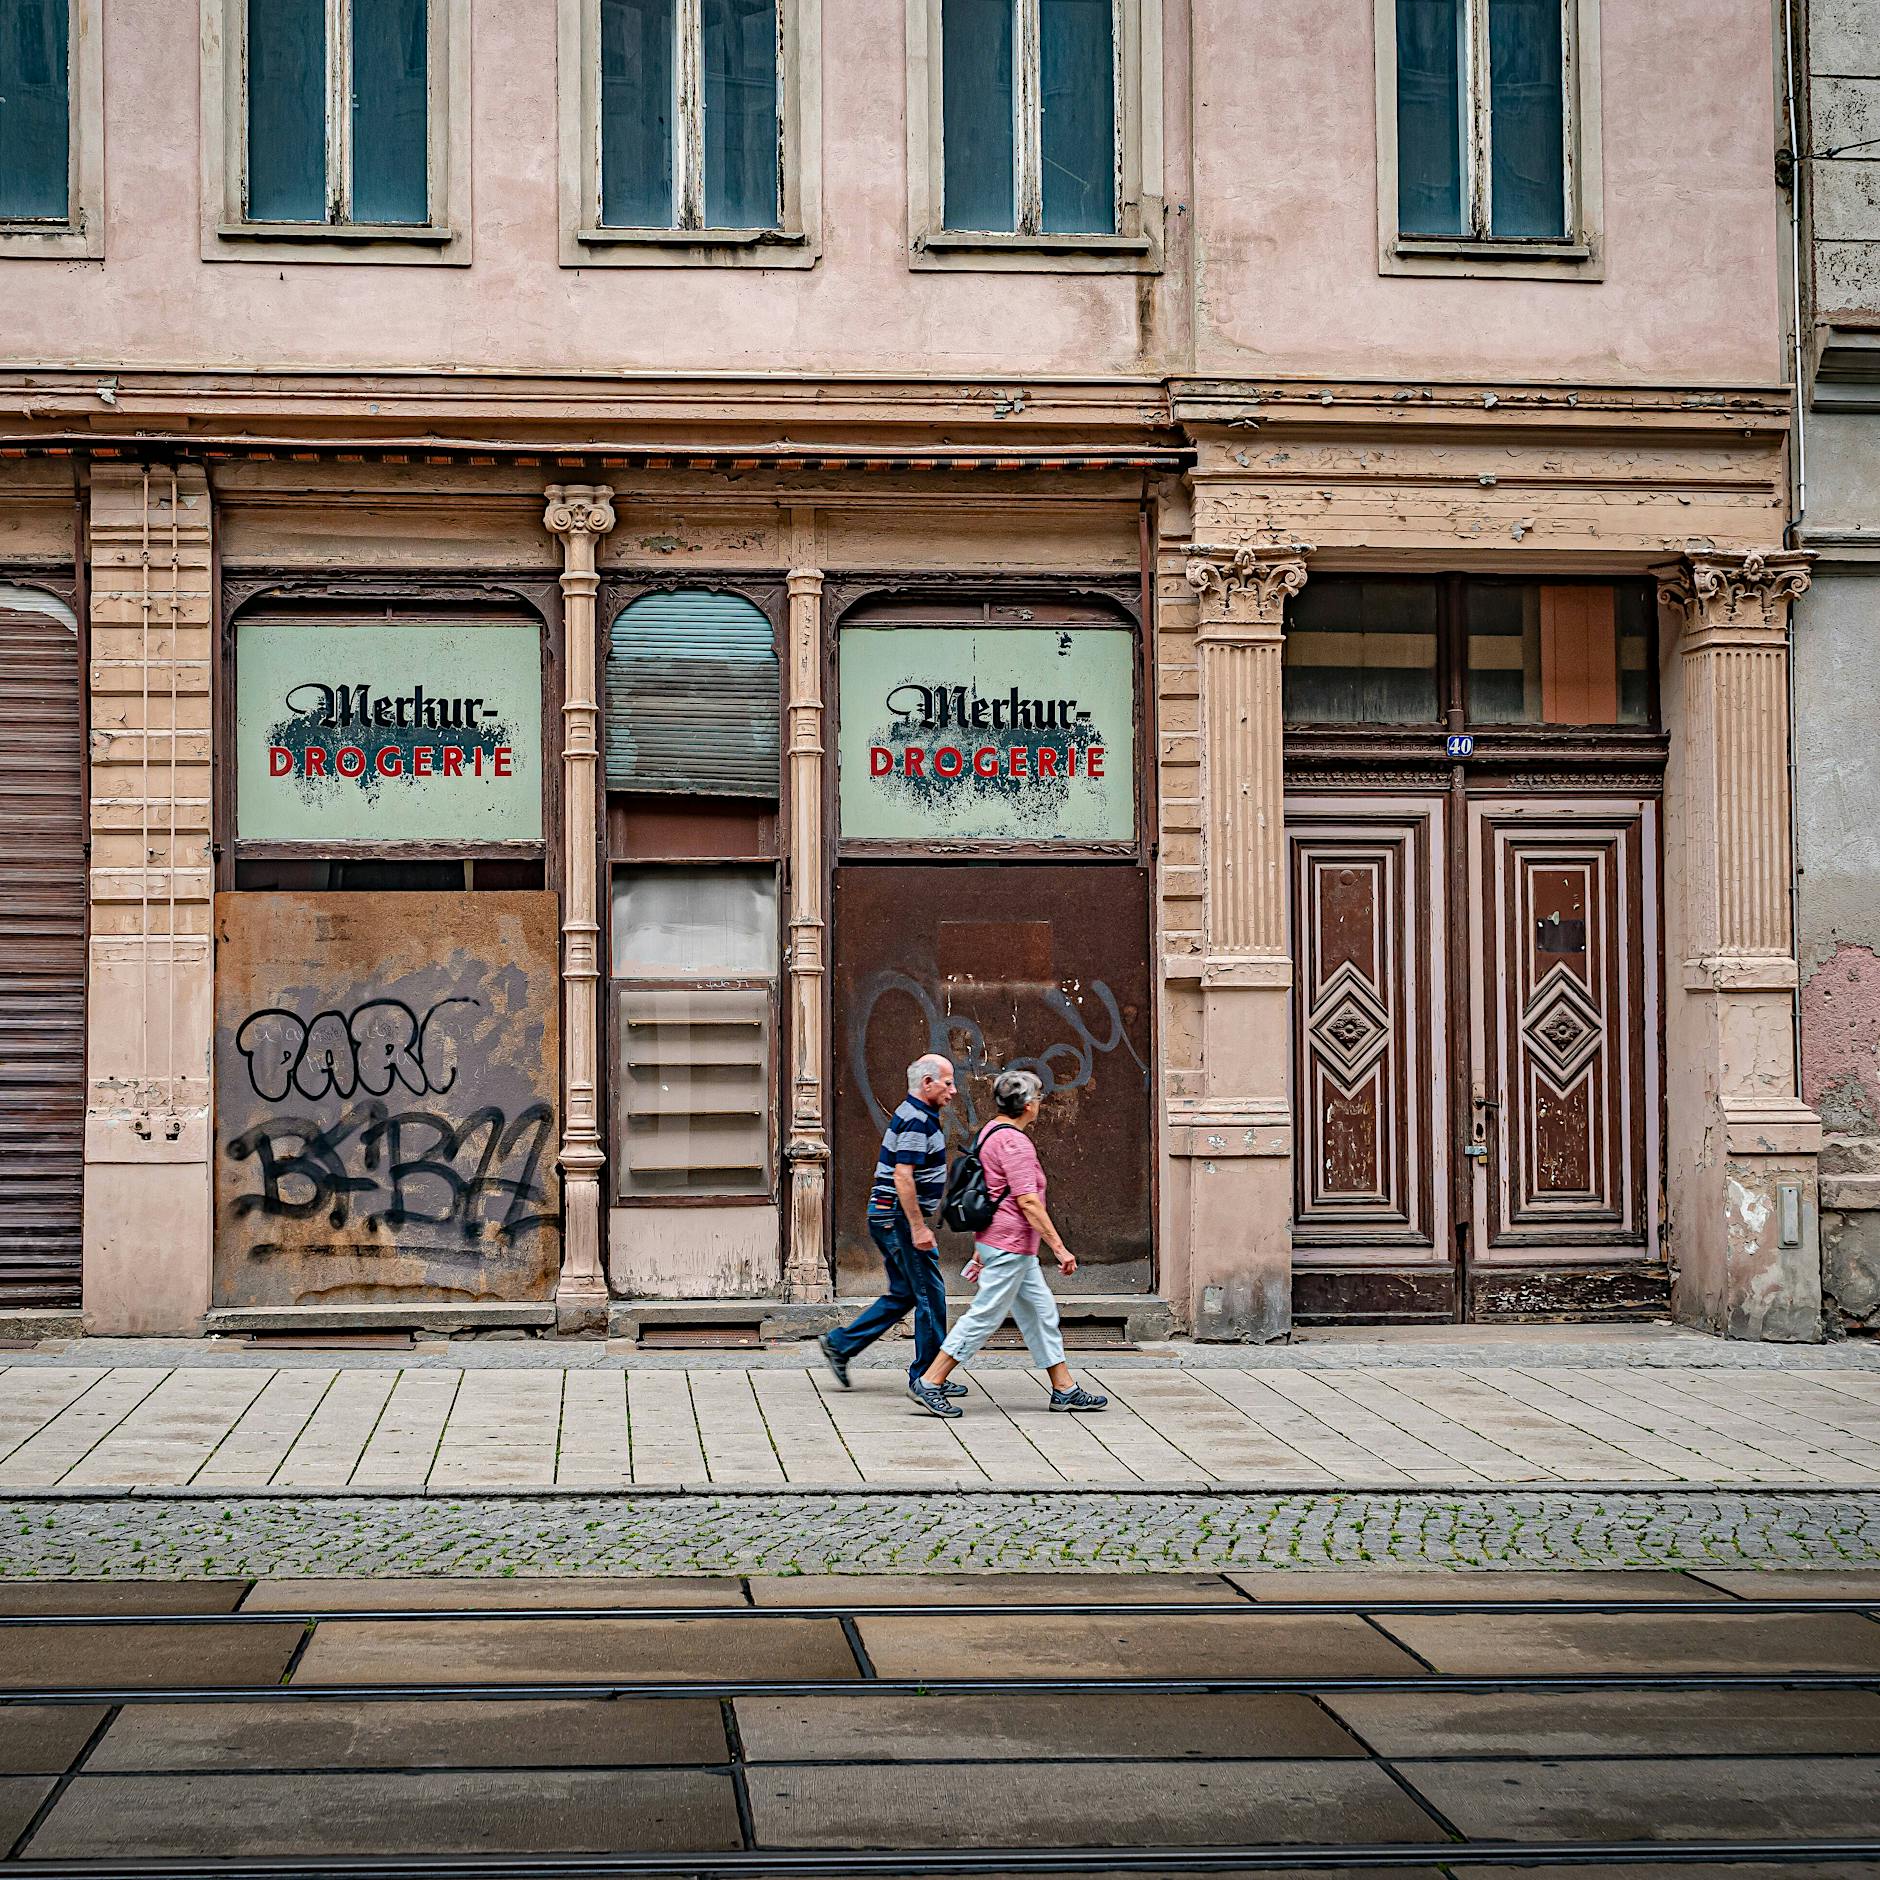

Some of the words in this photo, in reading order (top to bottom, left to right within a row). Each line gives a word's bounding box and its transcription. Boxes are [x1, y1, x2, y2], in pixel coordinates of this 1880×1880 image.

[285, 683, 499, 730] Merkur-
[886, 684, 1091, 731] Merkur-
[269, 746, 512, 777] DROGERIE
[869, 746, 1105, 777] DROGERIE
[1449, 738, 1472, 755] 40
